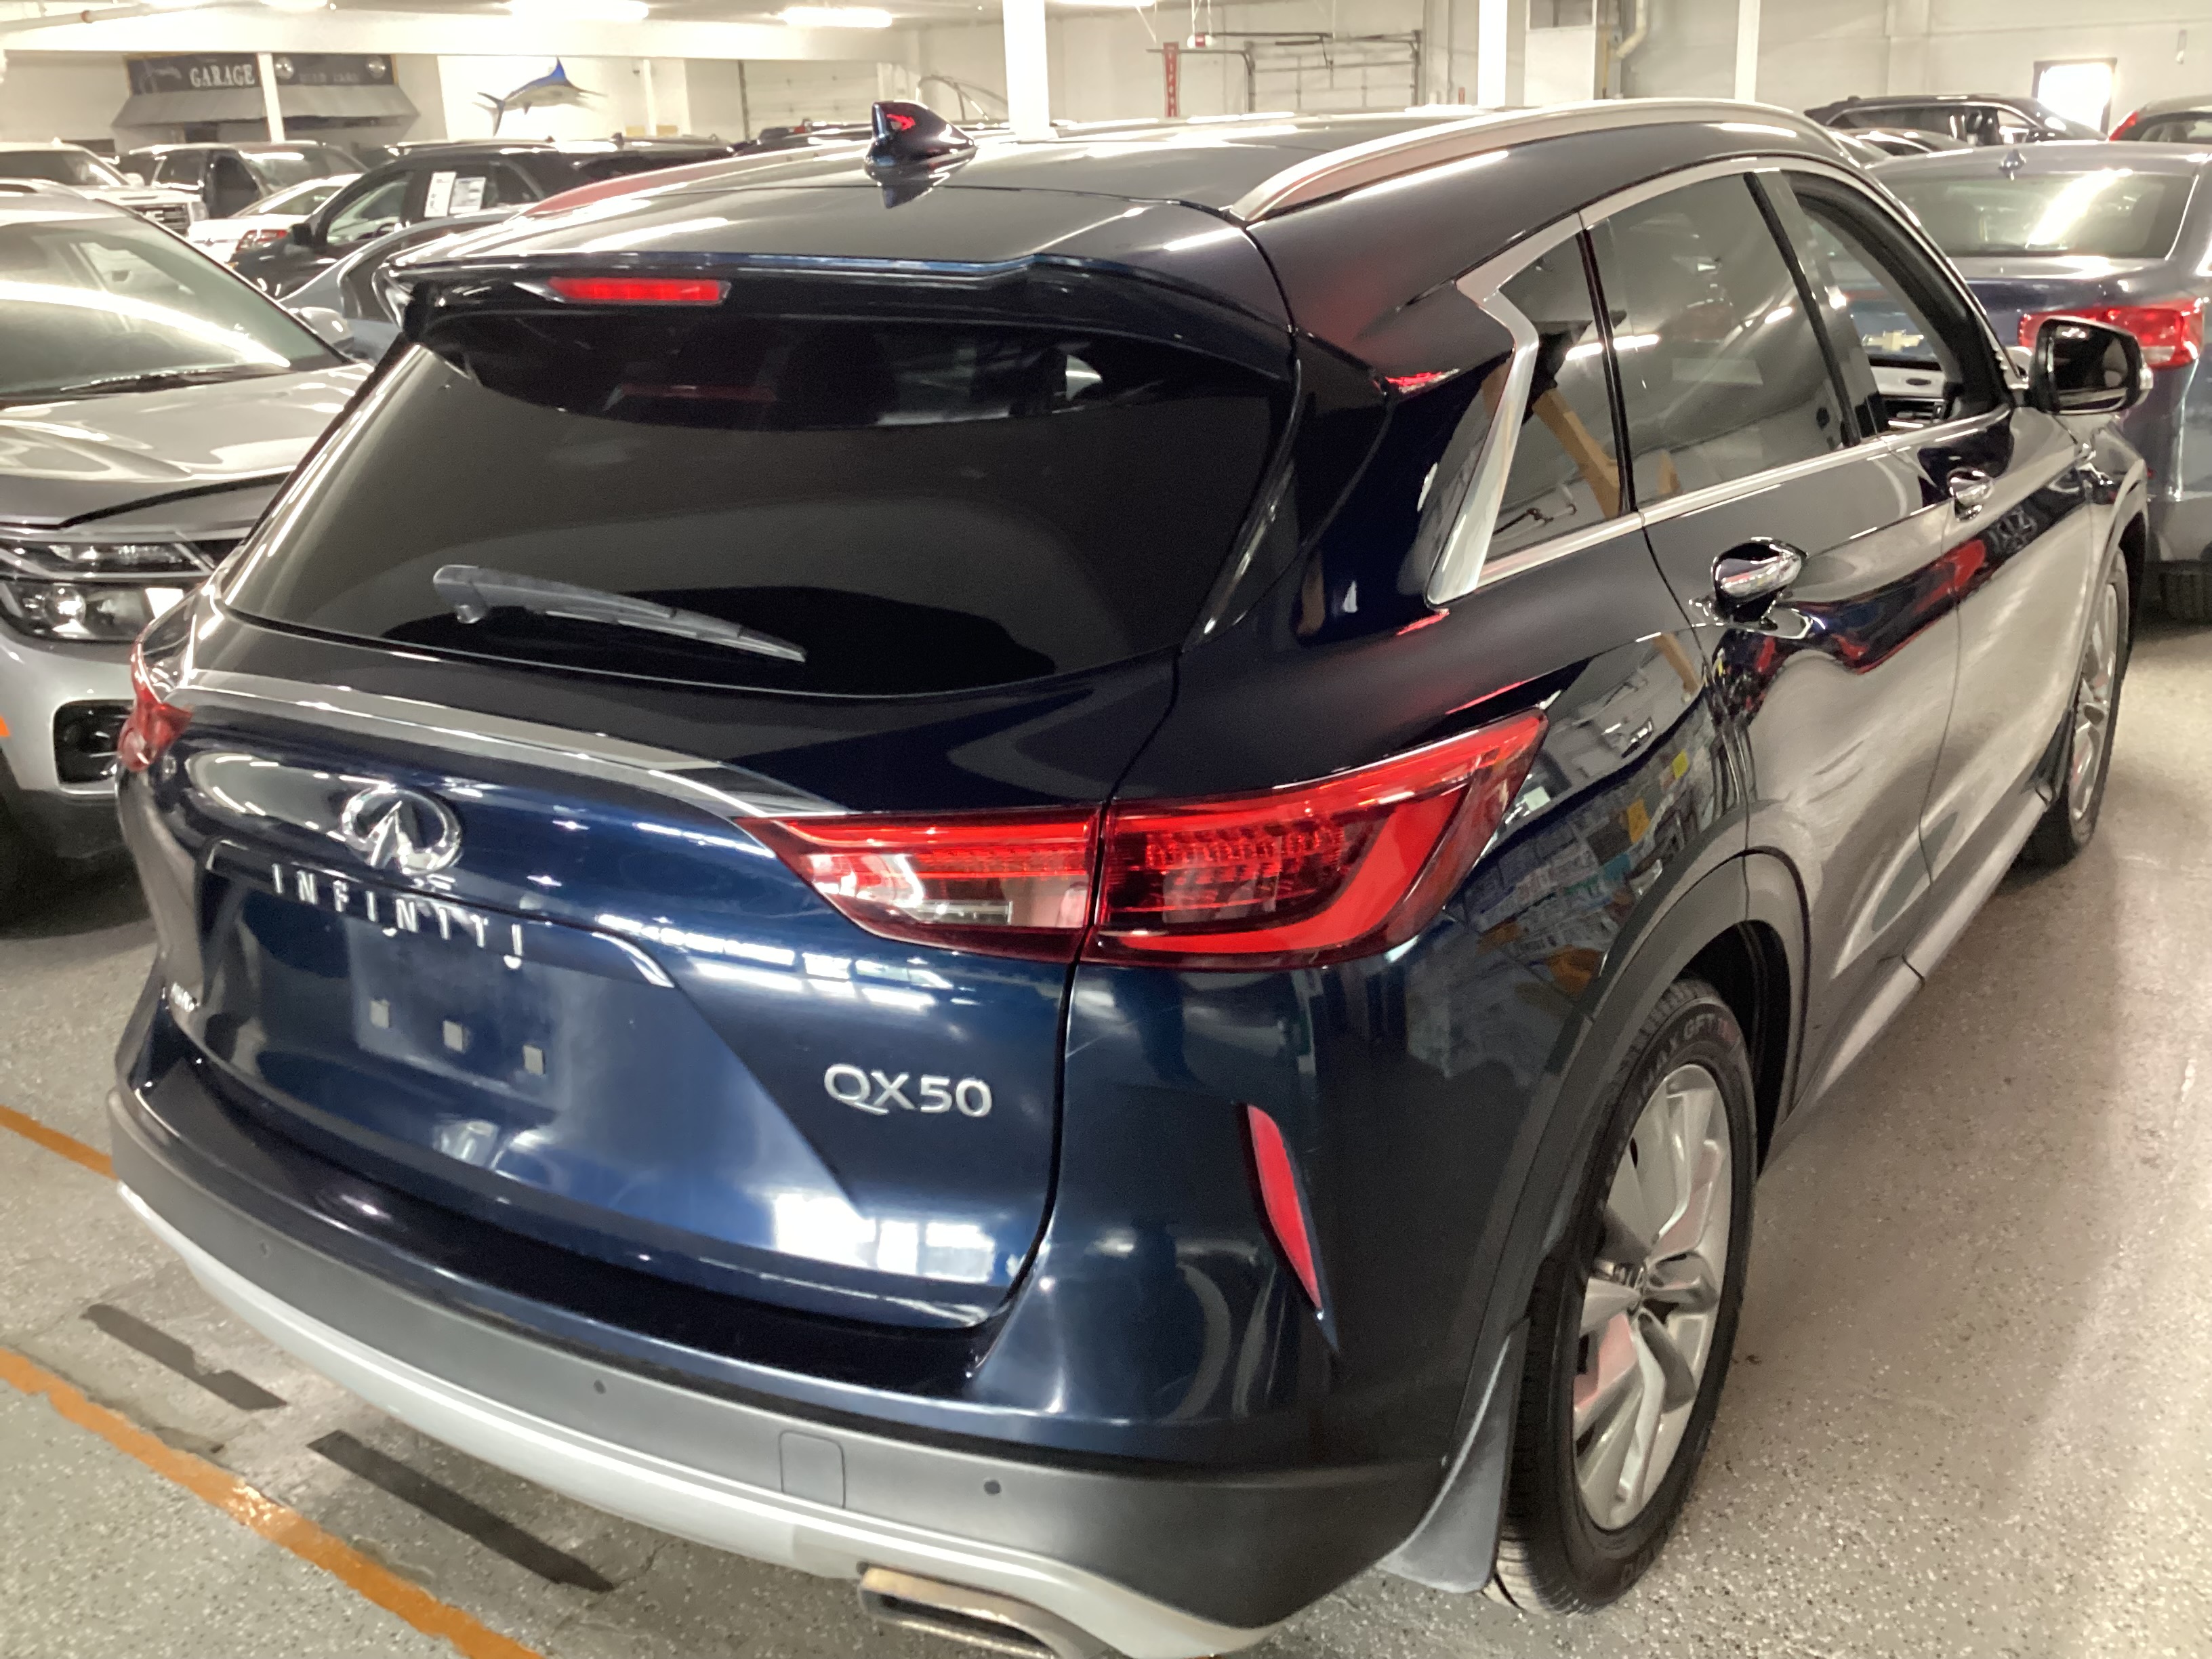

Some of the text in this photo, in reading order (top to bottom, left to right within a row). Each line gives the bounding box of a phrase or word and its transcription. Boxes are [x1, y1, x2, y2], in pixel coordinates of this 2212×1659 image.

[189, 64, 255, 88] GARAGE
[272, 863, 523, 957] INFINITI
[823, 1063, 993, 1117] QX50
